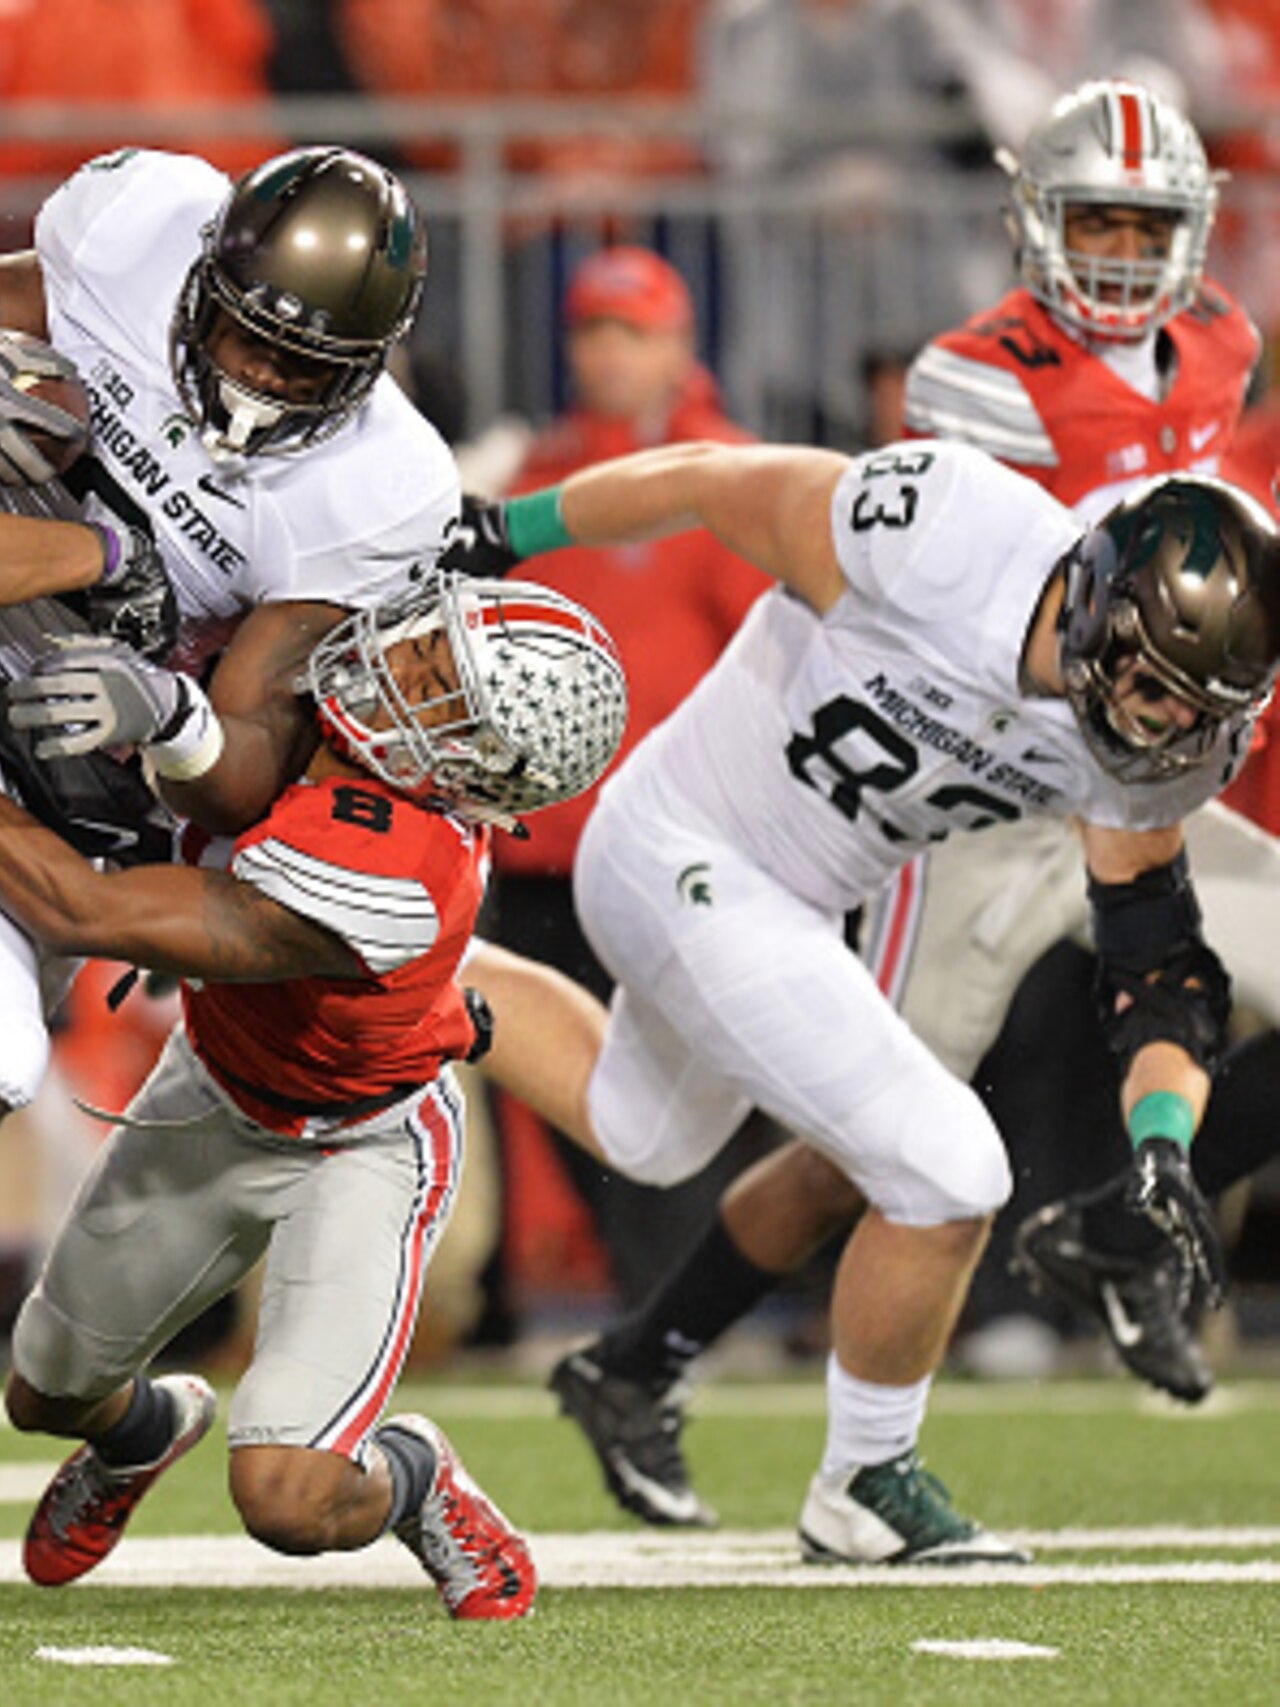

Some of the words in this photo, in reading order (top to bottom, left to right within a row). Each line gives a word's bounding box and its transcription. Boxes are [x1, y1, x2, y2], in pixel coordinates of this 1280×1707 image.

[162, 491, 246, 576] STATE
[863, 673, 994, 773] MICHIGAN
[331, 784, 393, 834] 8
